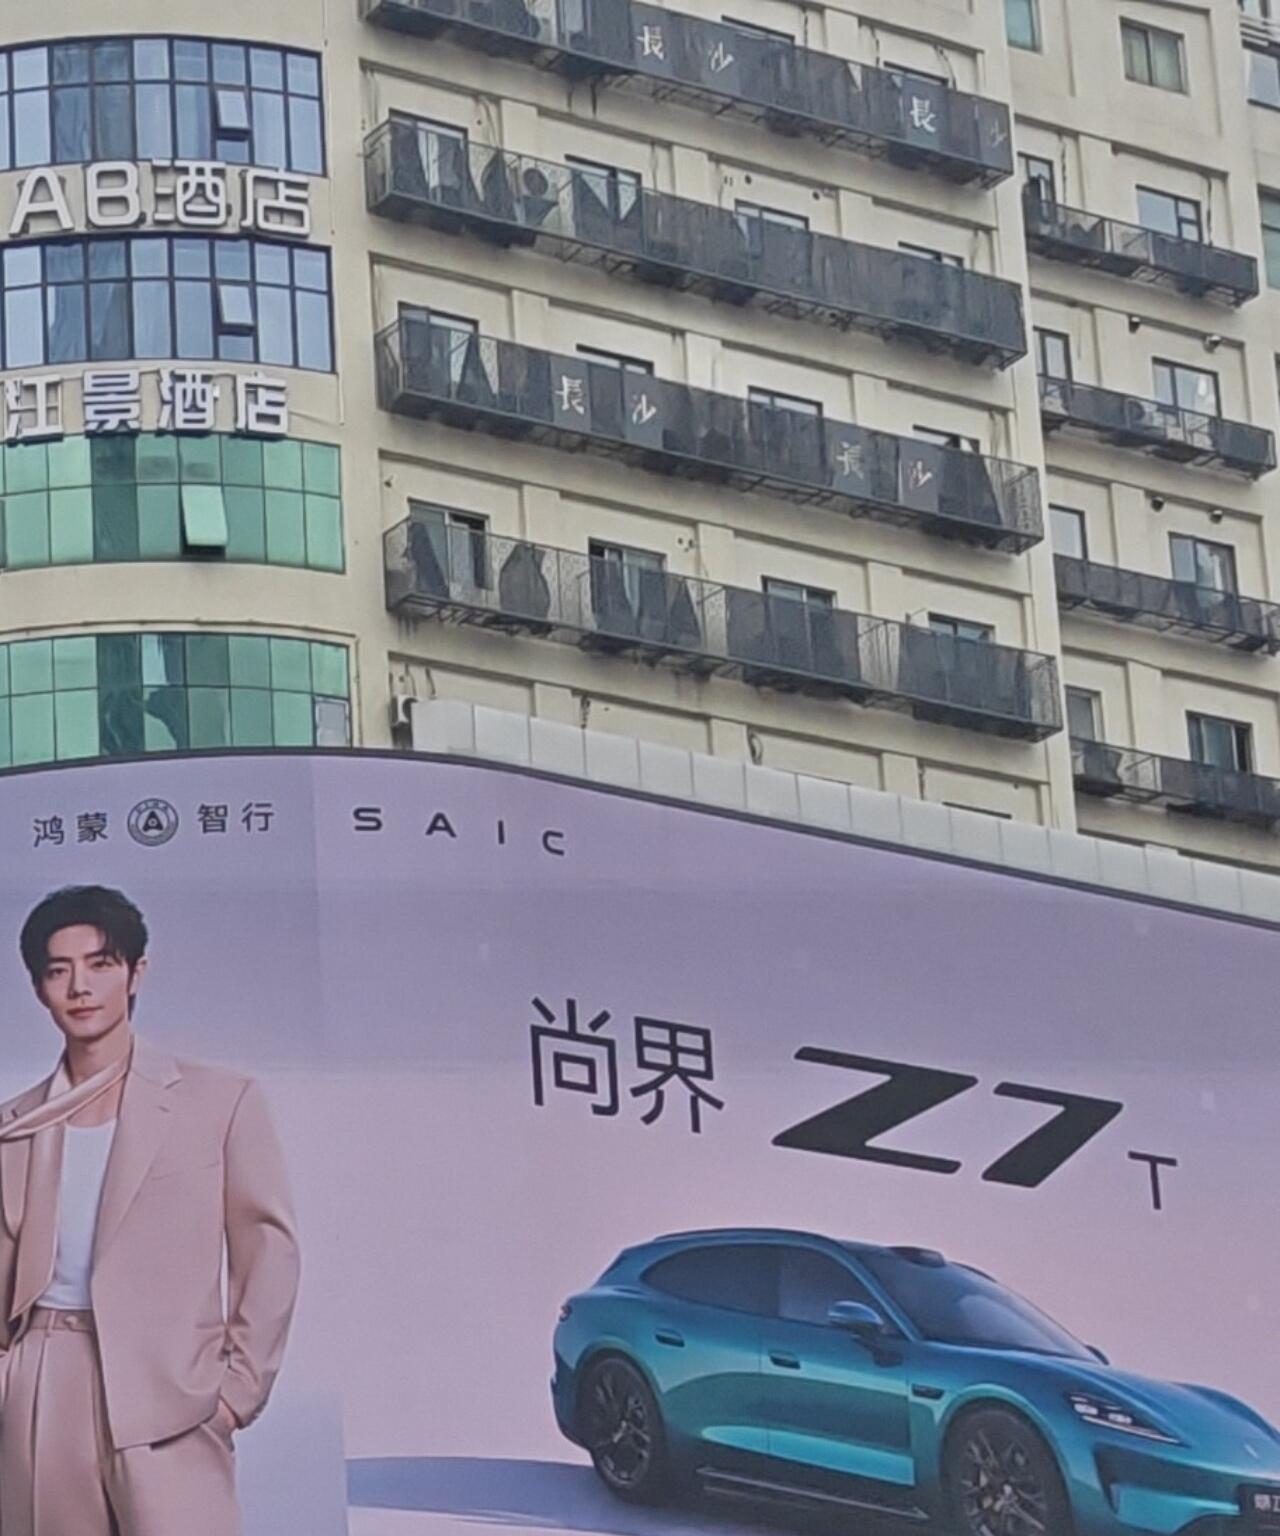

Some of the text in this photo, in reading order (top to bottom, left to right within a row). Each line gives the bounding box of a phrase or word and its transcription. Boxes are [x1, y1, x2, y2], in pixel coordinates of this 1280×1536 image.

[33, 801, 276, 847] 鸿蒙 智行
[353, 808, 566, 857] SAIC
[529, 996, 725, 1134] 尚界
